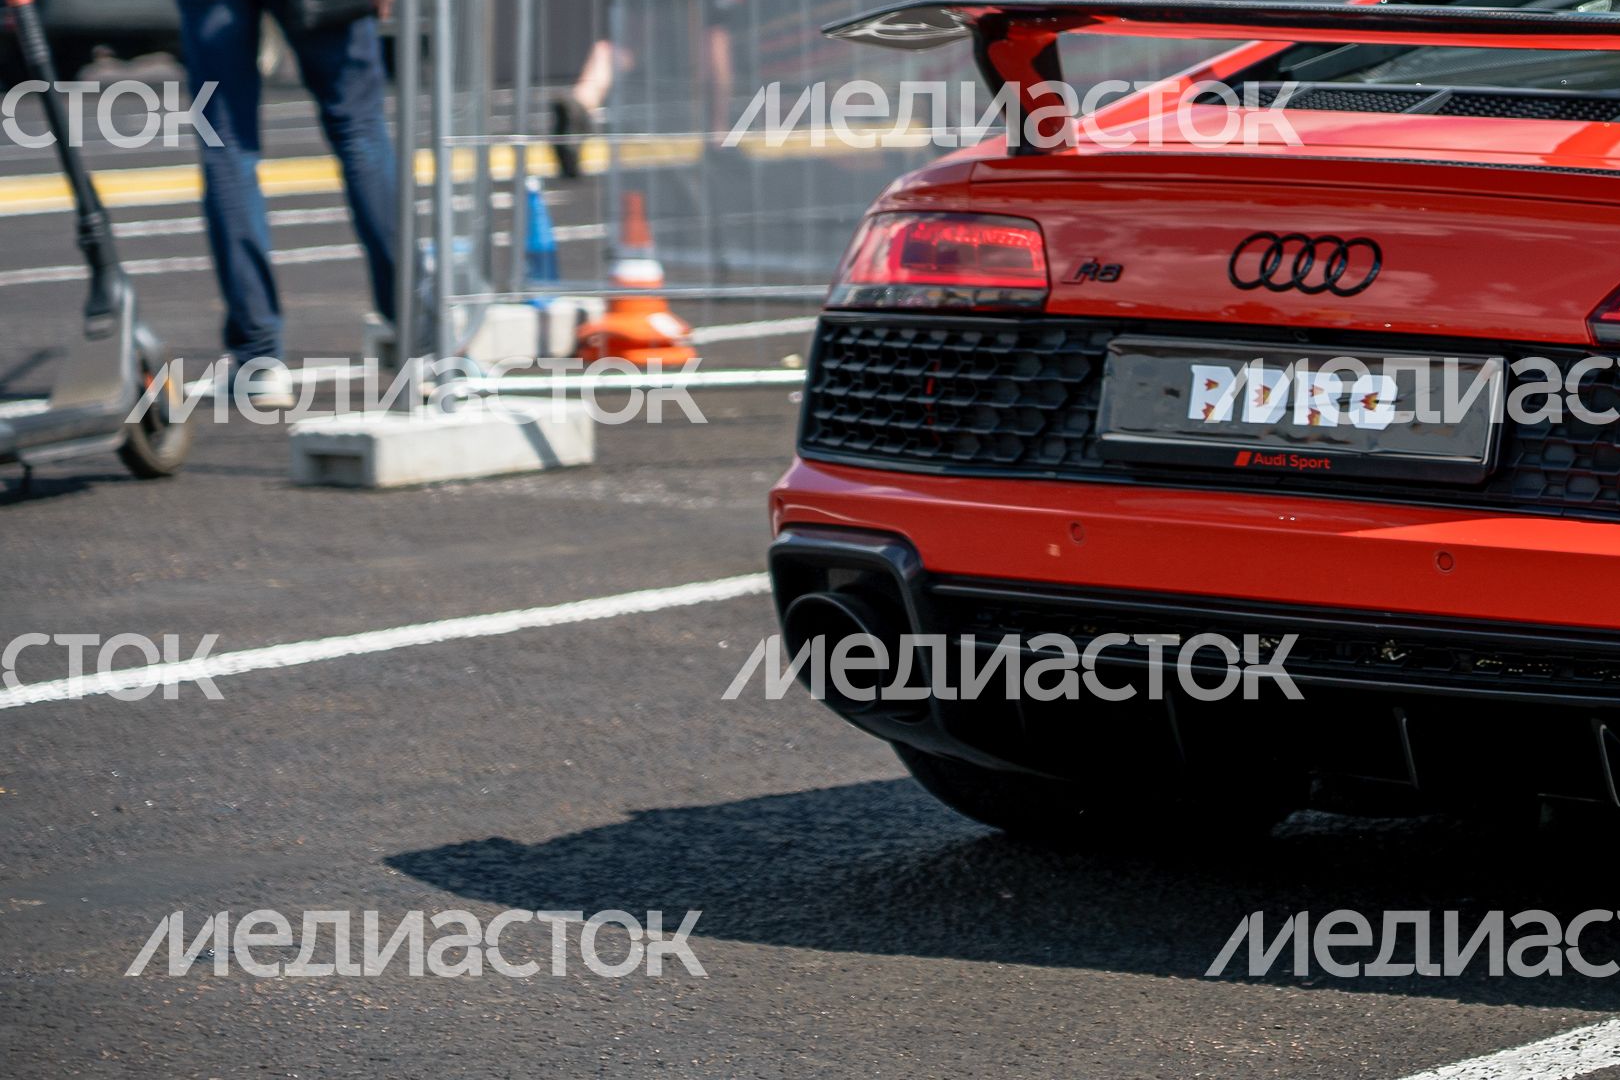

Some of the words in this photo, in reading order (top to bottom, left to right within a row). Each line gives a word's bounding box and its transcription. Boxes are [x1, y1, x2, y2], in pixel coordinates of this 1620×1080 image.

[1074, 263, 1123, 282] R8
[1254, 453, 1287, 467] Audi
[1290, 454, 1331, 470] Sport
